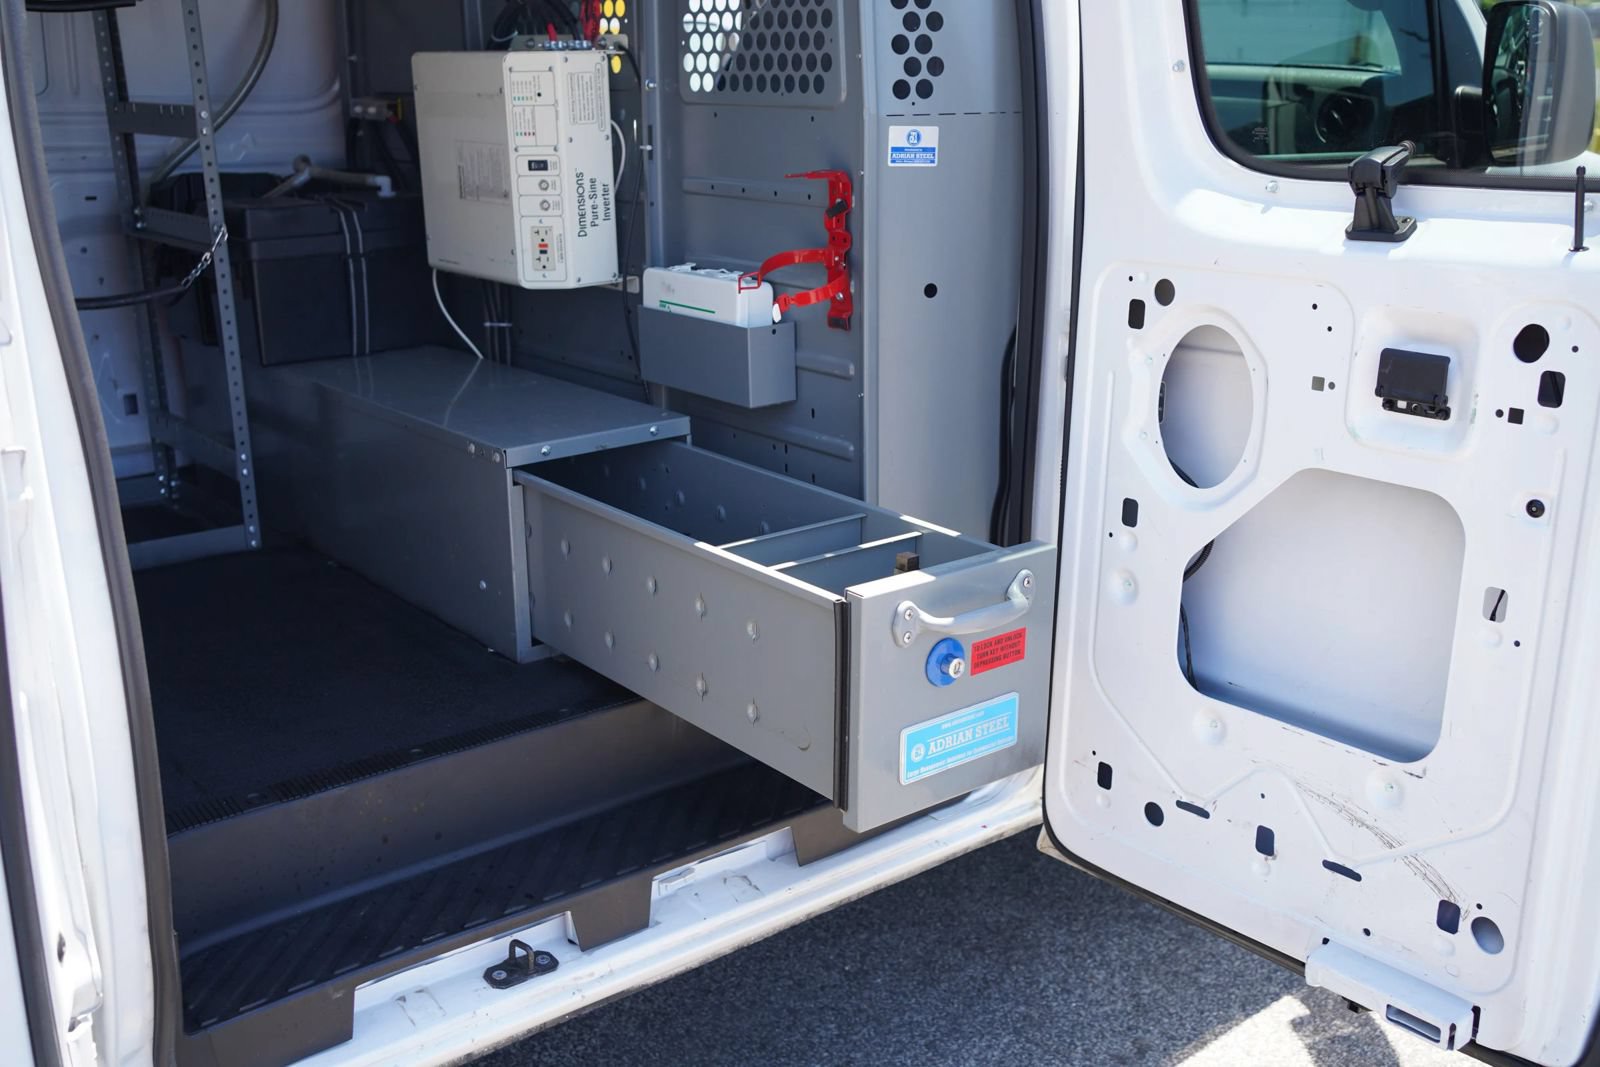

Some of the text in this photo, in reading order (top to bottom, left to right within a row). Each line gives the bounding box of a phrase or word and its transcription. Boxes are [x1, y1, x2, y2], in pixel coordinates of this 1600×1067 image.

[588, 177, 599, 227] Pure-Sine
[602, 183, 611, 221] Inverter
[927, 729, 974, 755] ADRIAN
[975, 715, 1010, 738] STEEL
